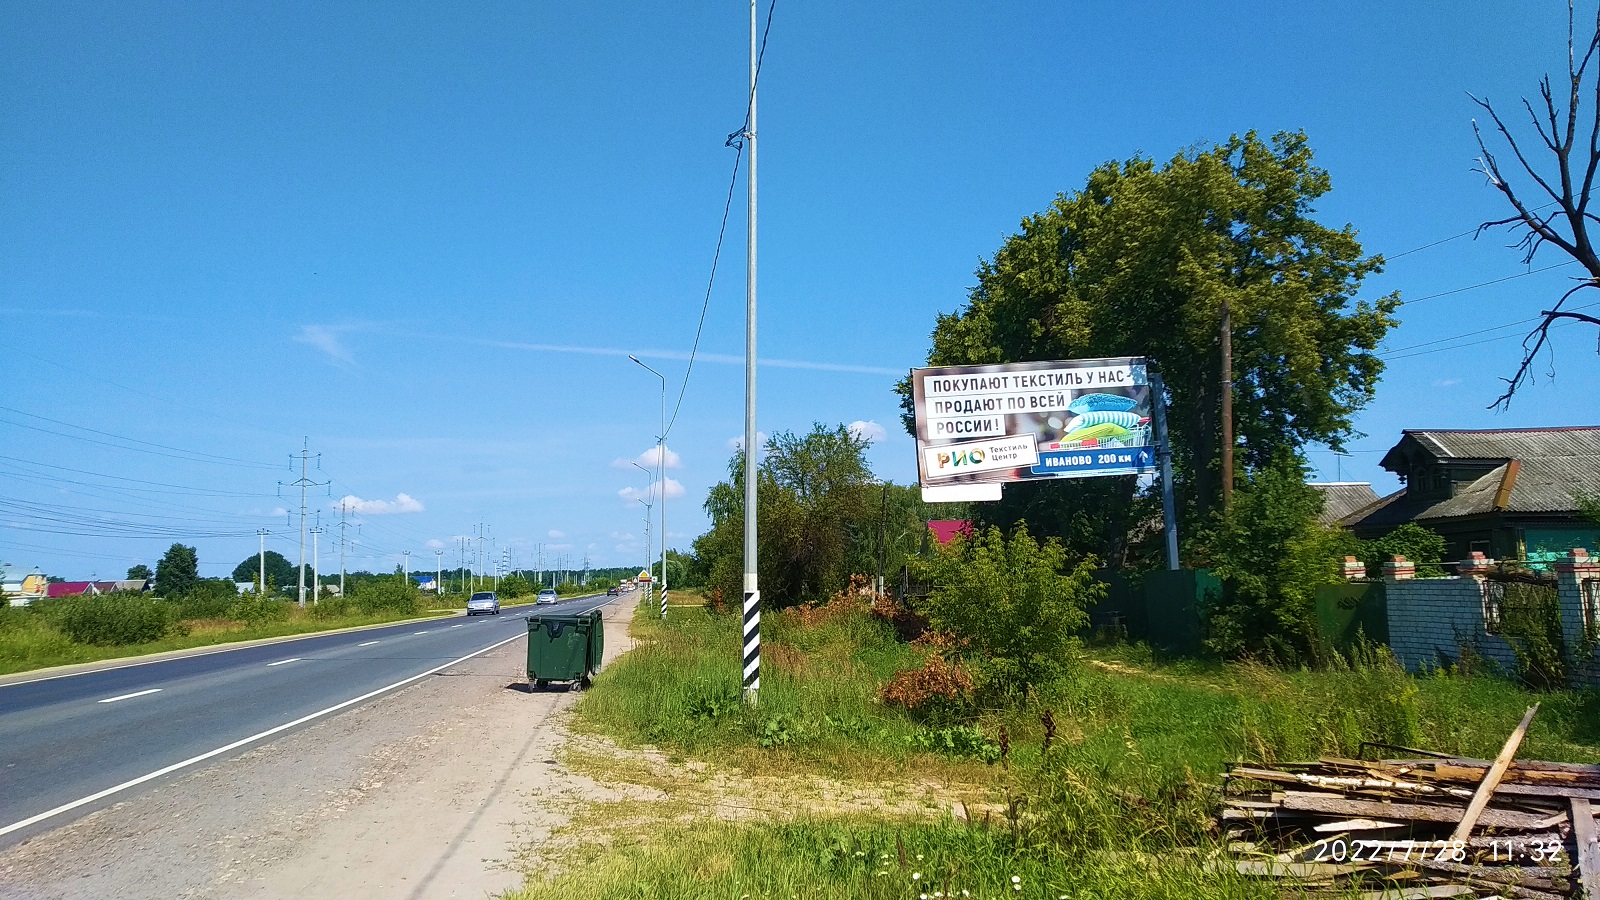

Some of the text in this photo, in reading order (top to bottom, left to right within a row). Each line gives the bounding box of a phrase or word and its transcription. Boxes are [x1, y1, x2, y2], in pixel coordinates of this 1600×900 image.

[933, 376, 1009, 393] ПОКУПАЮТ
[1013, 372, 1083, 388] ТЕКСТИЛЬ
[1087, 371, 1094, 384] У
[935, 392, 1065, 414] ПРОДАЮТ ПО ВСЕЙ
[936, 418, 1000, 435] РОССИИ!
[990, 443, 1028, 453] Текстиль
[991, 452, 1018, 461] Центр
[937, 447, 986, 469] РИО
[1045, 454, 1092, 467] ИВАНОВО
[1098, 453, 1116, 464] 200
